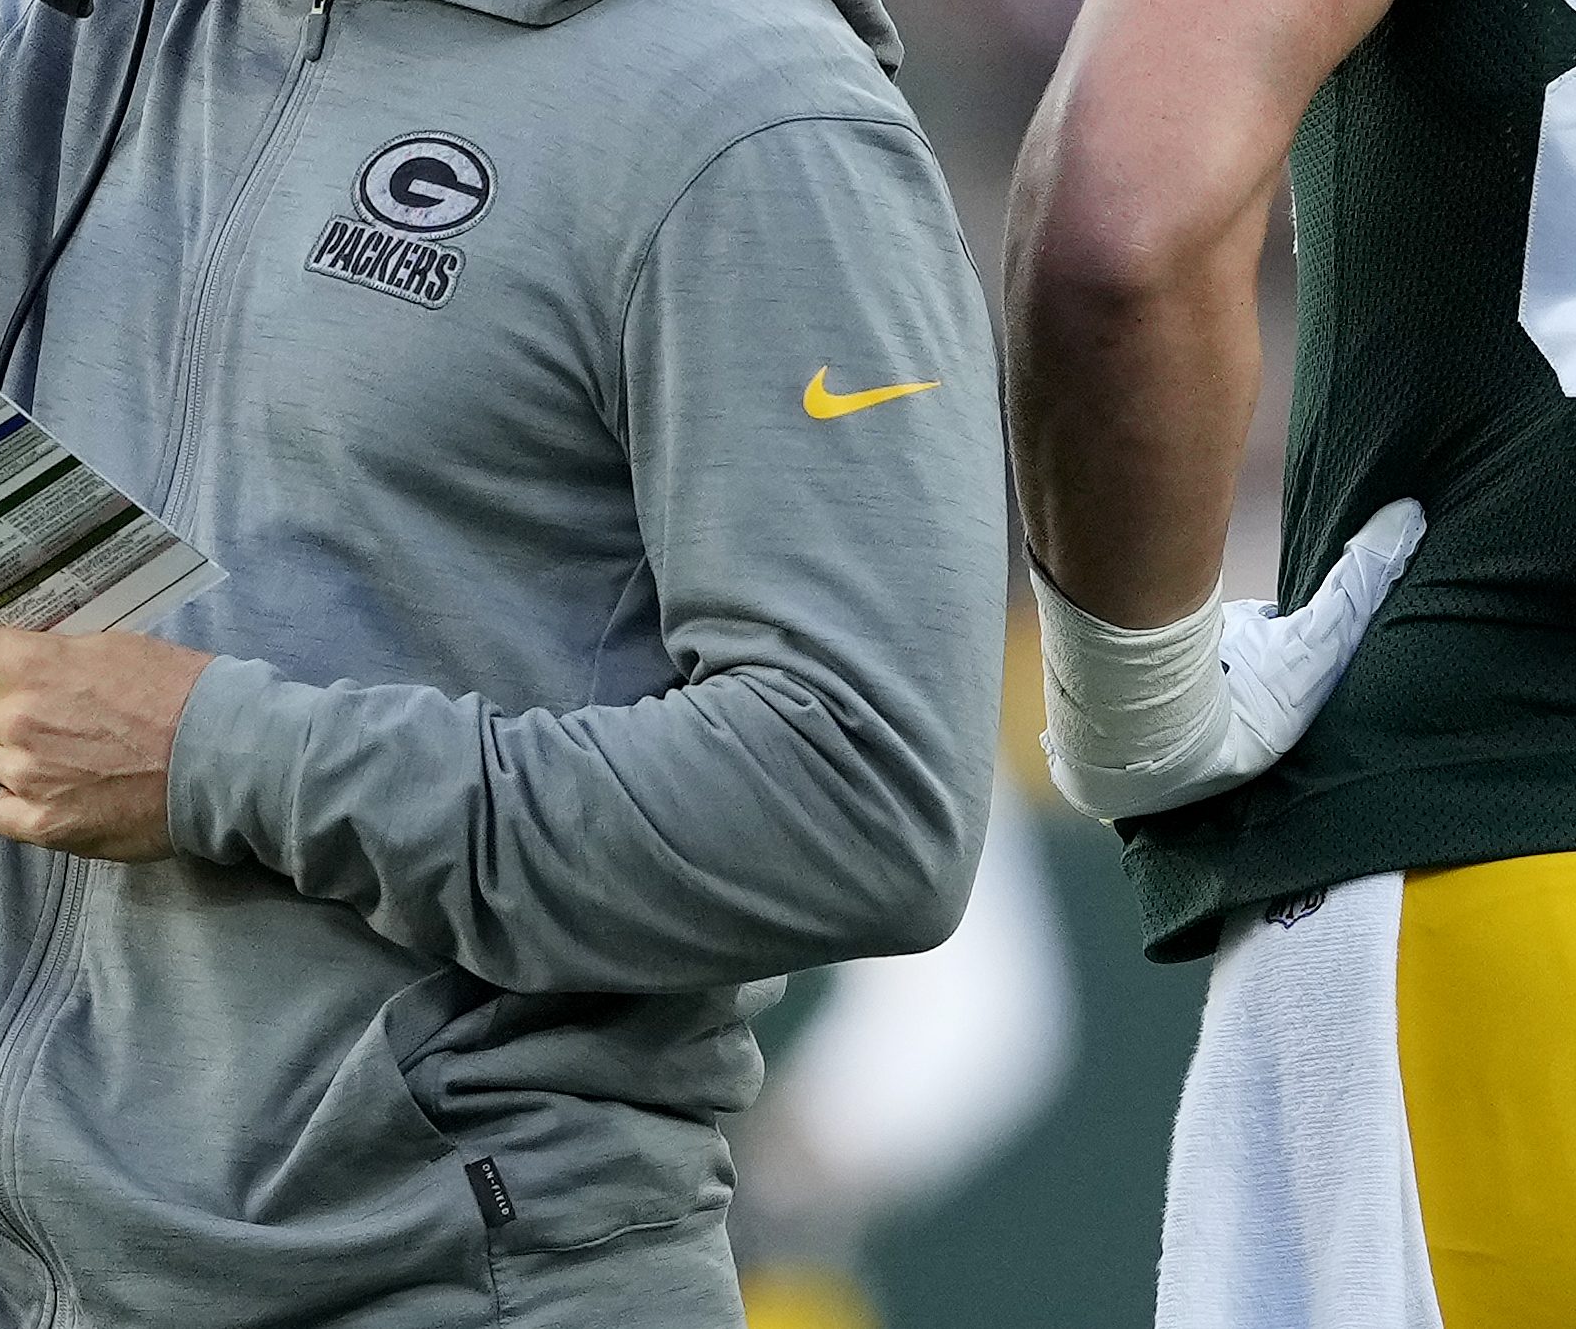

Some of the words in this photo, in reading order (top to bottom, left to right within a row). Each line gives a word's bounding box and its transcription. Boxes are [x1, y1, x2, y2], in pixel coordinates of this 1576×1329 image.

[364, 141, 483, 229] G
[312, 221, 458, 302] PACKERS
[482, 1163, 510, 1216] ON-FIELD
